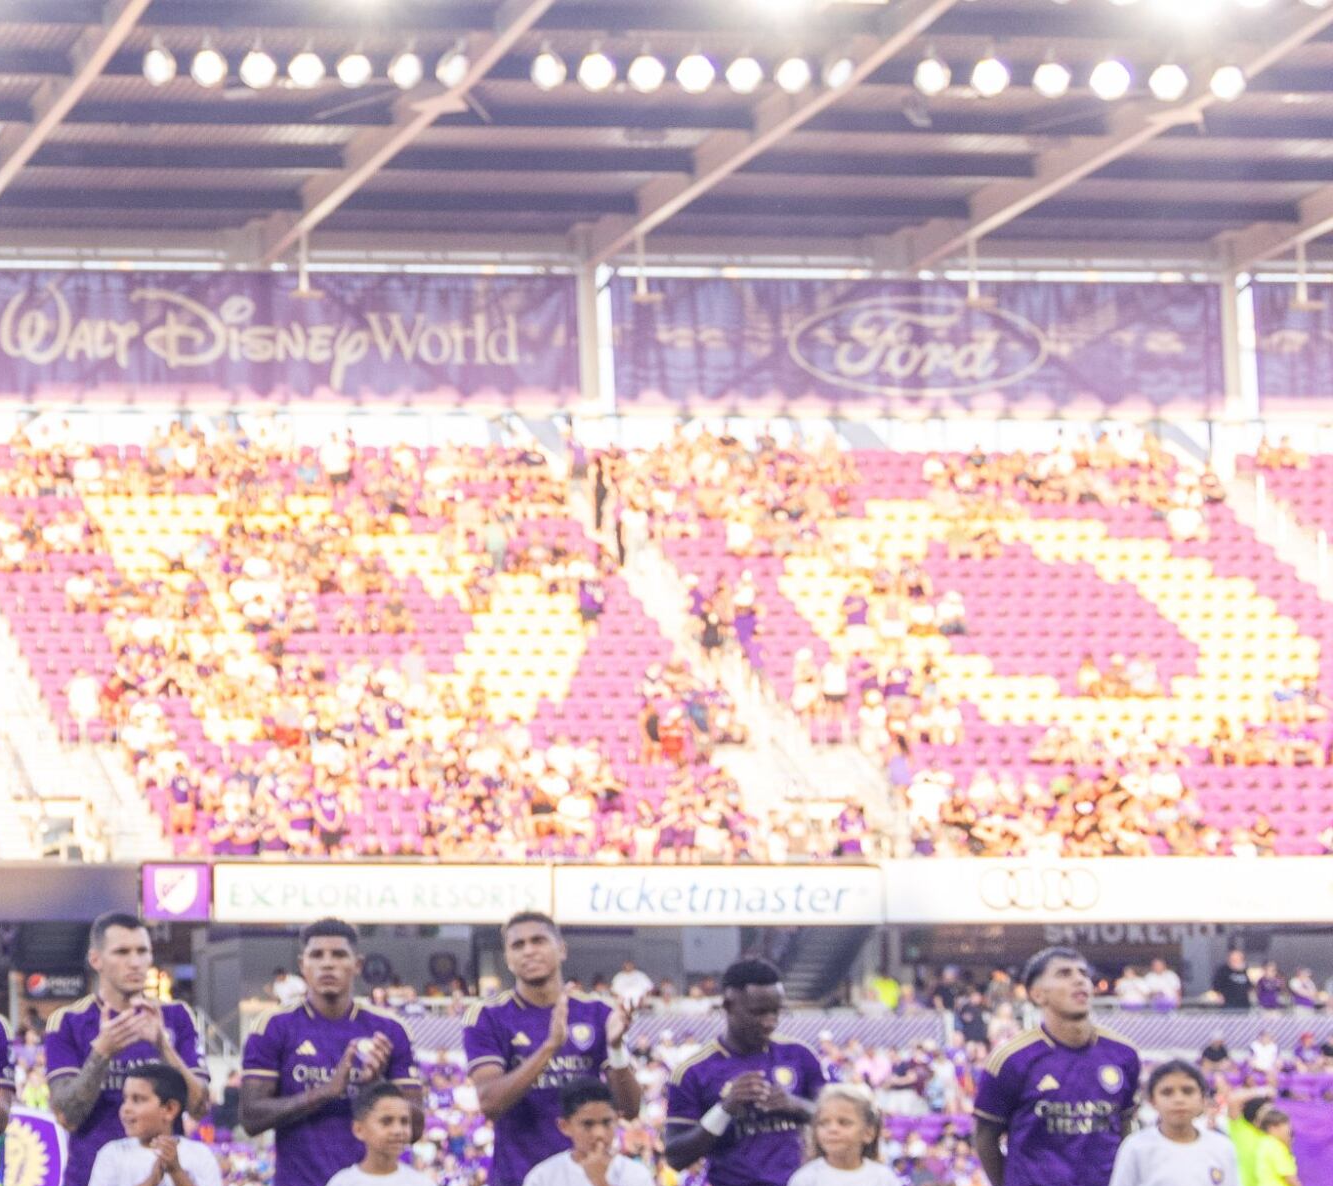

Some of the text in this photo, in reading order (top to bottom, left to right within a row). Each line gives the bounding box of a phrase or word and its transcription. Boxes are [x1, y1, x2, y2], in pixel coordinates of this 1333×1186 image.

[366, 311, 520, 365] World
[833, 307, 999, 380] Ford
[229, 881, 399, 908] EXPLORIA
[589, 877, 850, 914] ticketmaster
